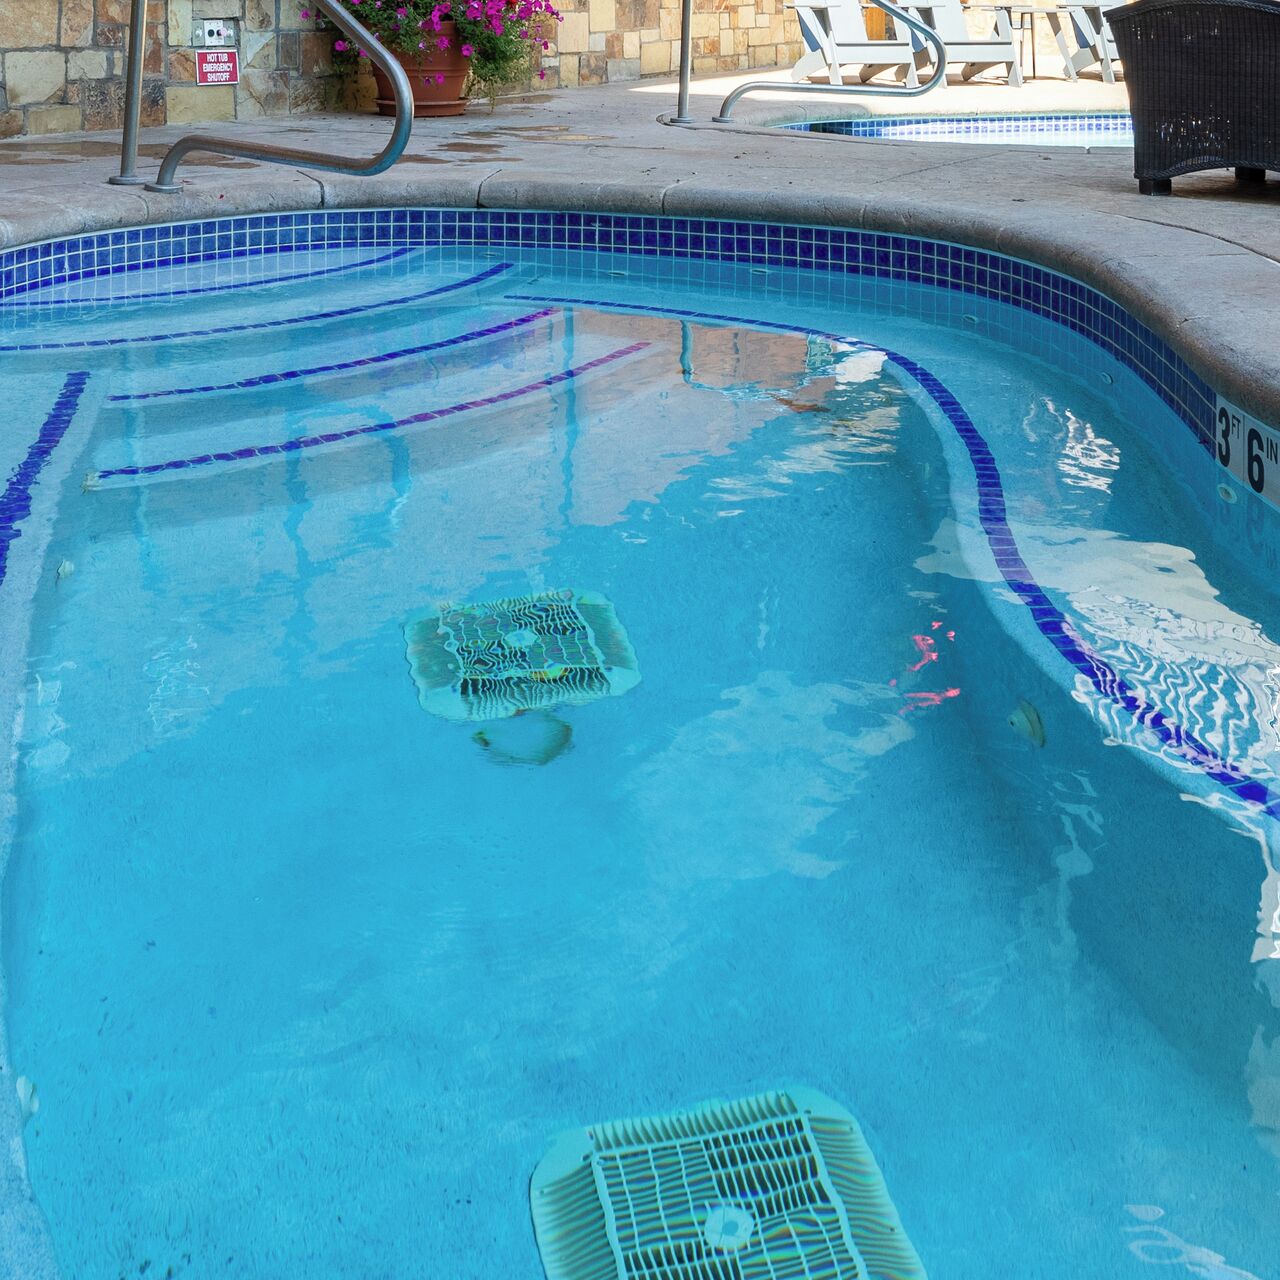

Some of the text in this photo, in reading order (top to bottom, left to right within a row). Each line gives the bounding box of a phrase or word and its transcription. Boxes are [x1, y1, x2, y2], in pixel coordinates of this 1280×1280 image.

[207, 53, 228, 62] HOT TUB
[203, 63, 233, 72] EMERGENCY
[208, 73, 230, 81] SHUTOFF
[1218, 407, 1278, 494] 3 FT 6 IN
